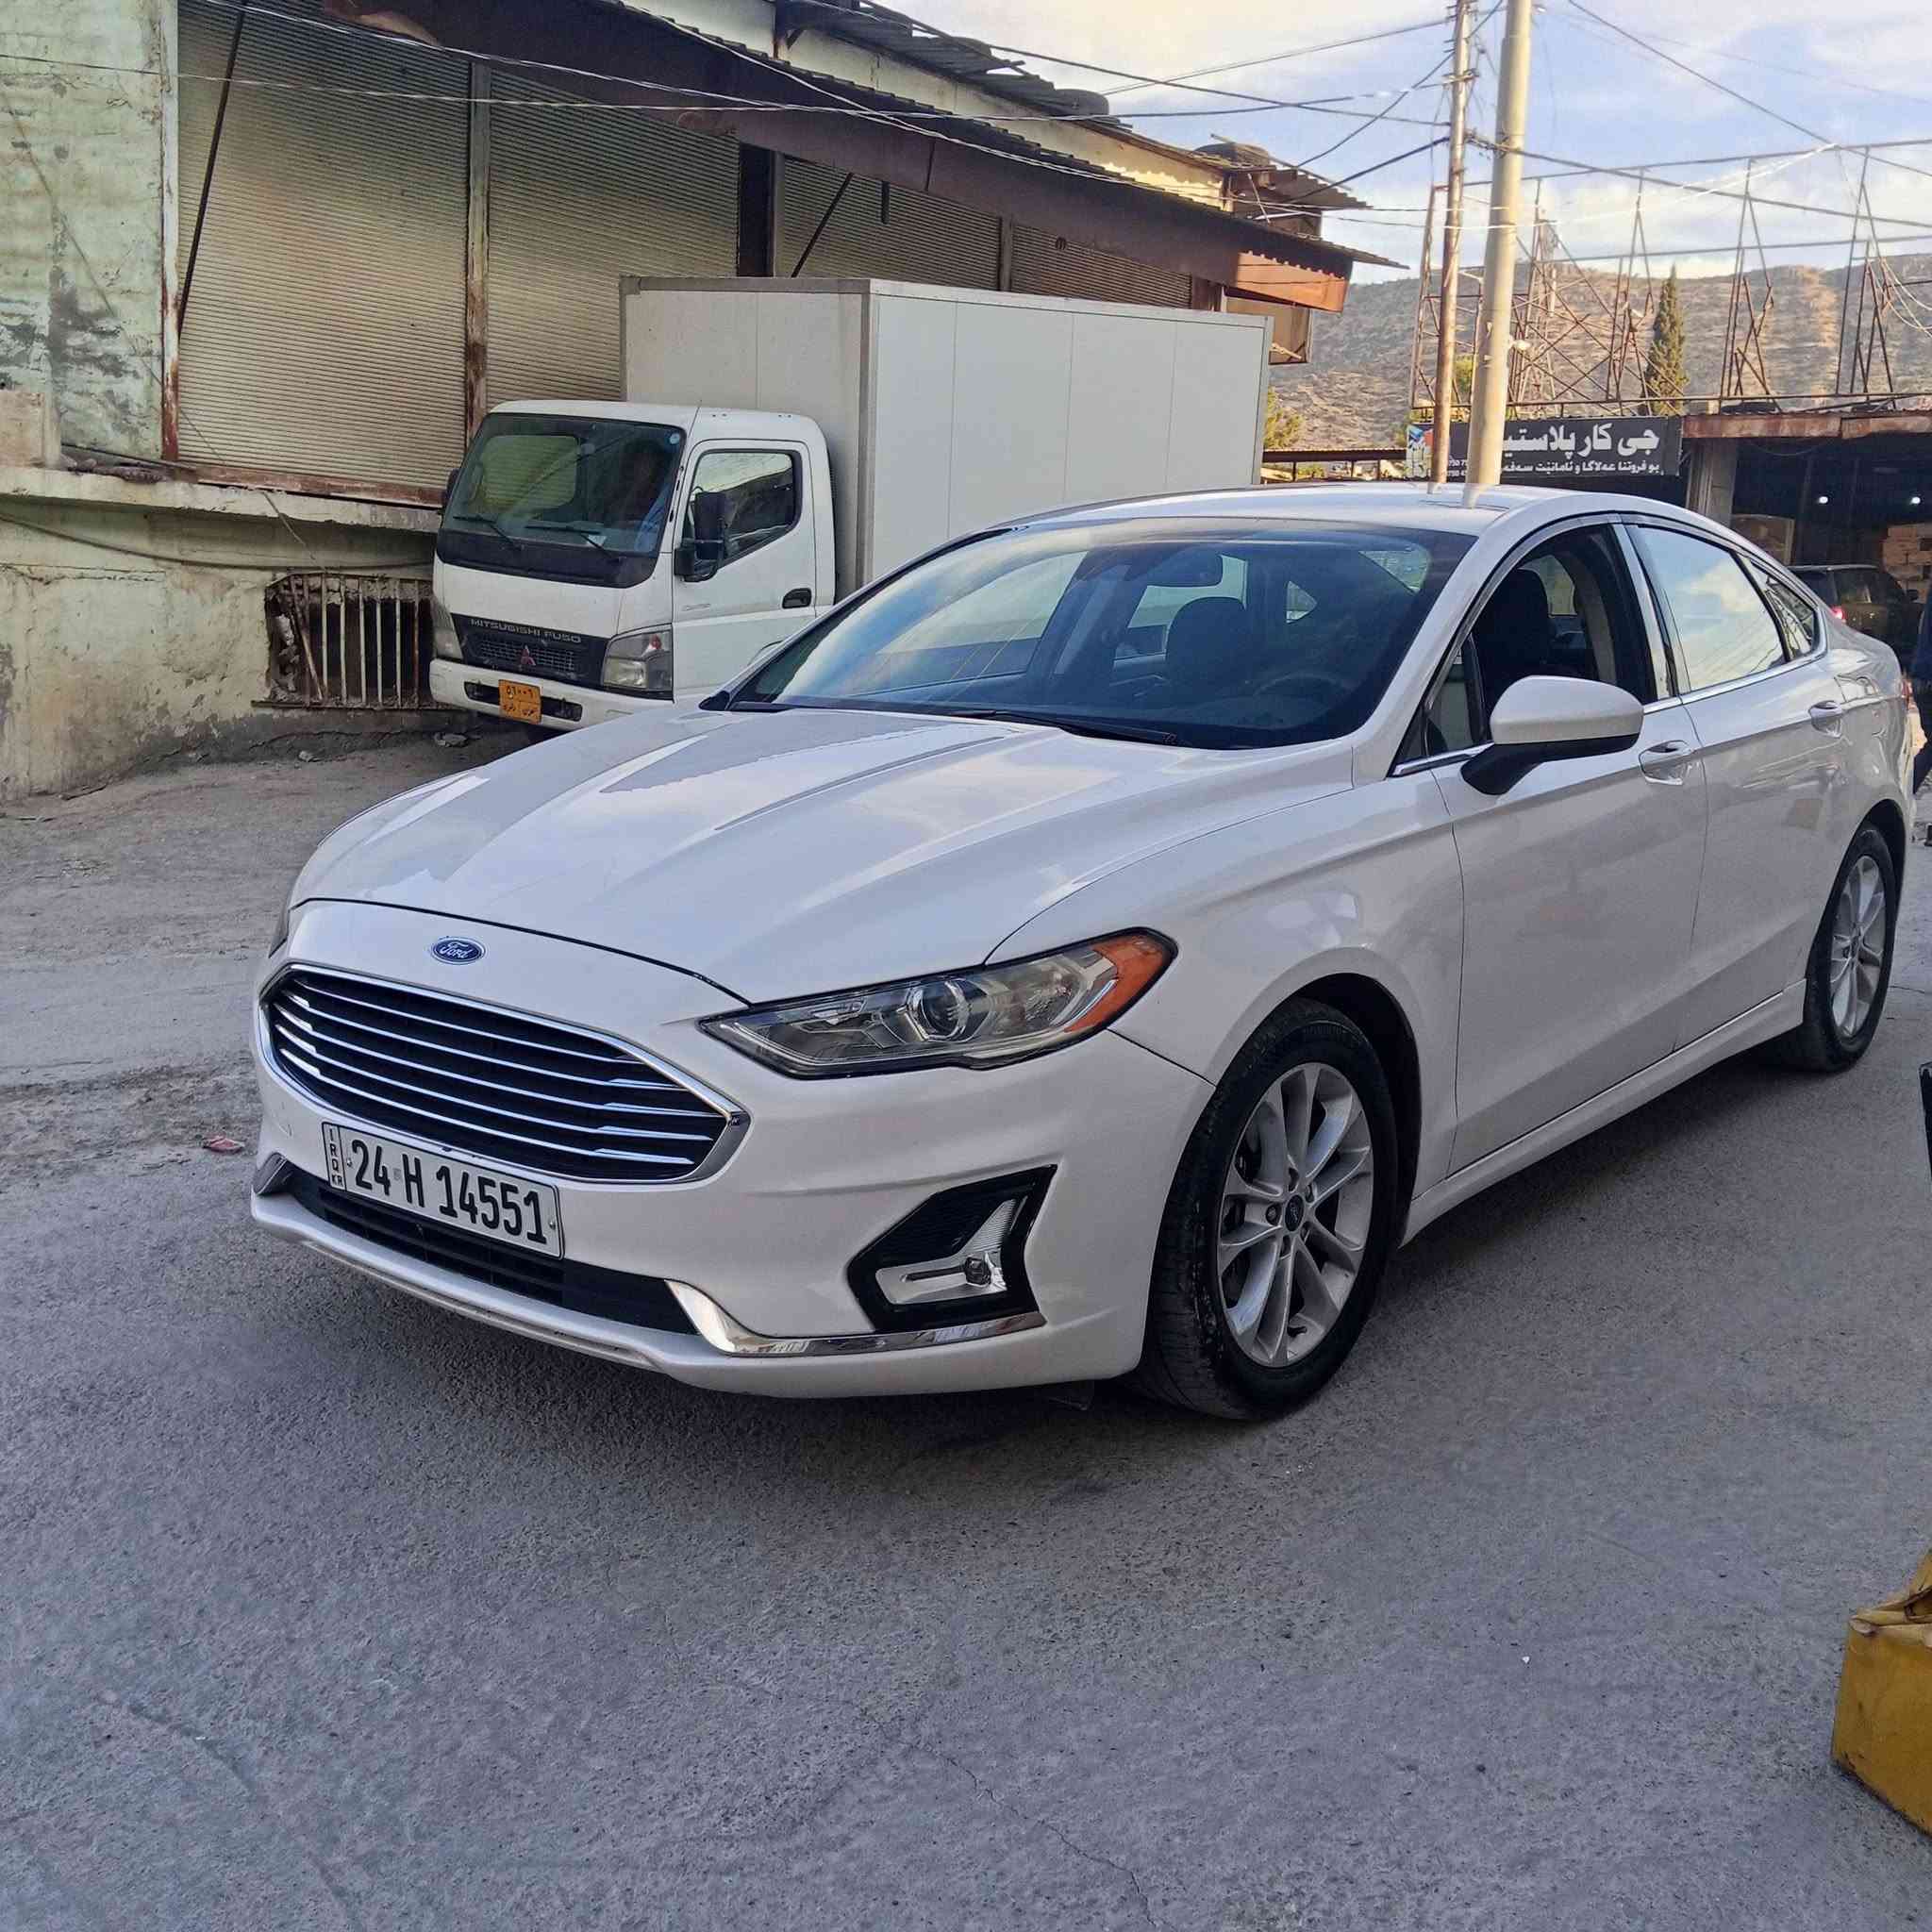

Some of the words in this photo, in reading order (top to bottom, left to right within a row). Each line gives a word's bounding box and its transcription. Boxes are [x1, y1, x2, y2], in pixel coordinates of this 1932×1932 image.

[1503, 425, 1576, 459] پلاستی
[471, 618, 541, 636] MITSUBISHI
[544, 631, 582, 643] FUSO
[440, 941, 473, 959] Ford
[352, 1140, 391, 1196] 24
[402, 1153, 425, 1208] H
[436, 1165, 547, 1245] 14551
